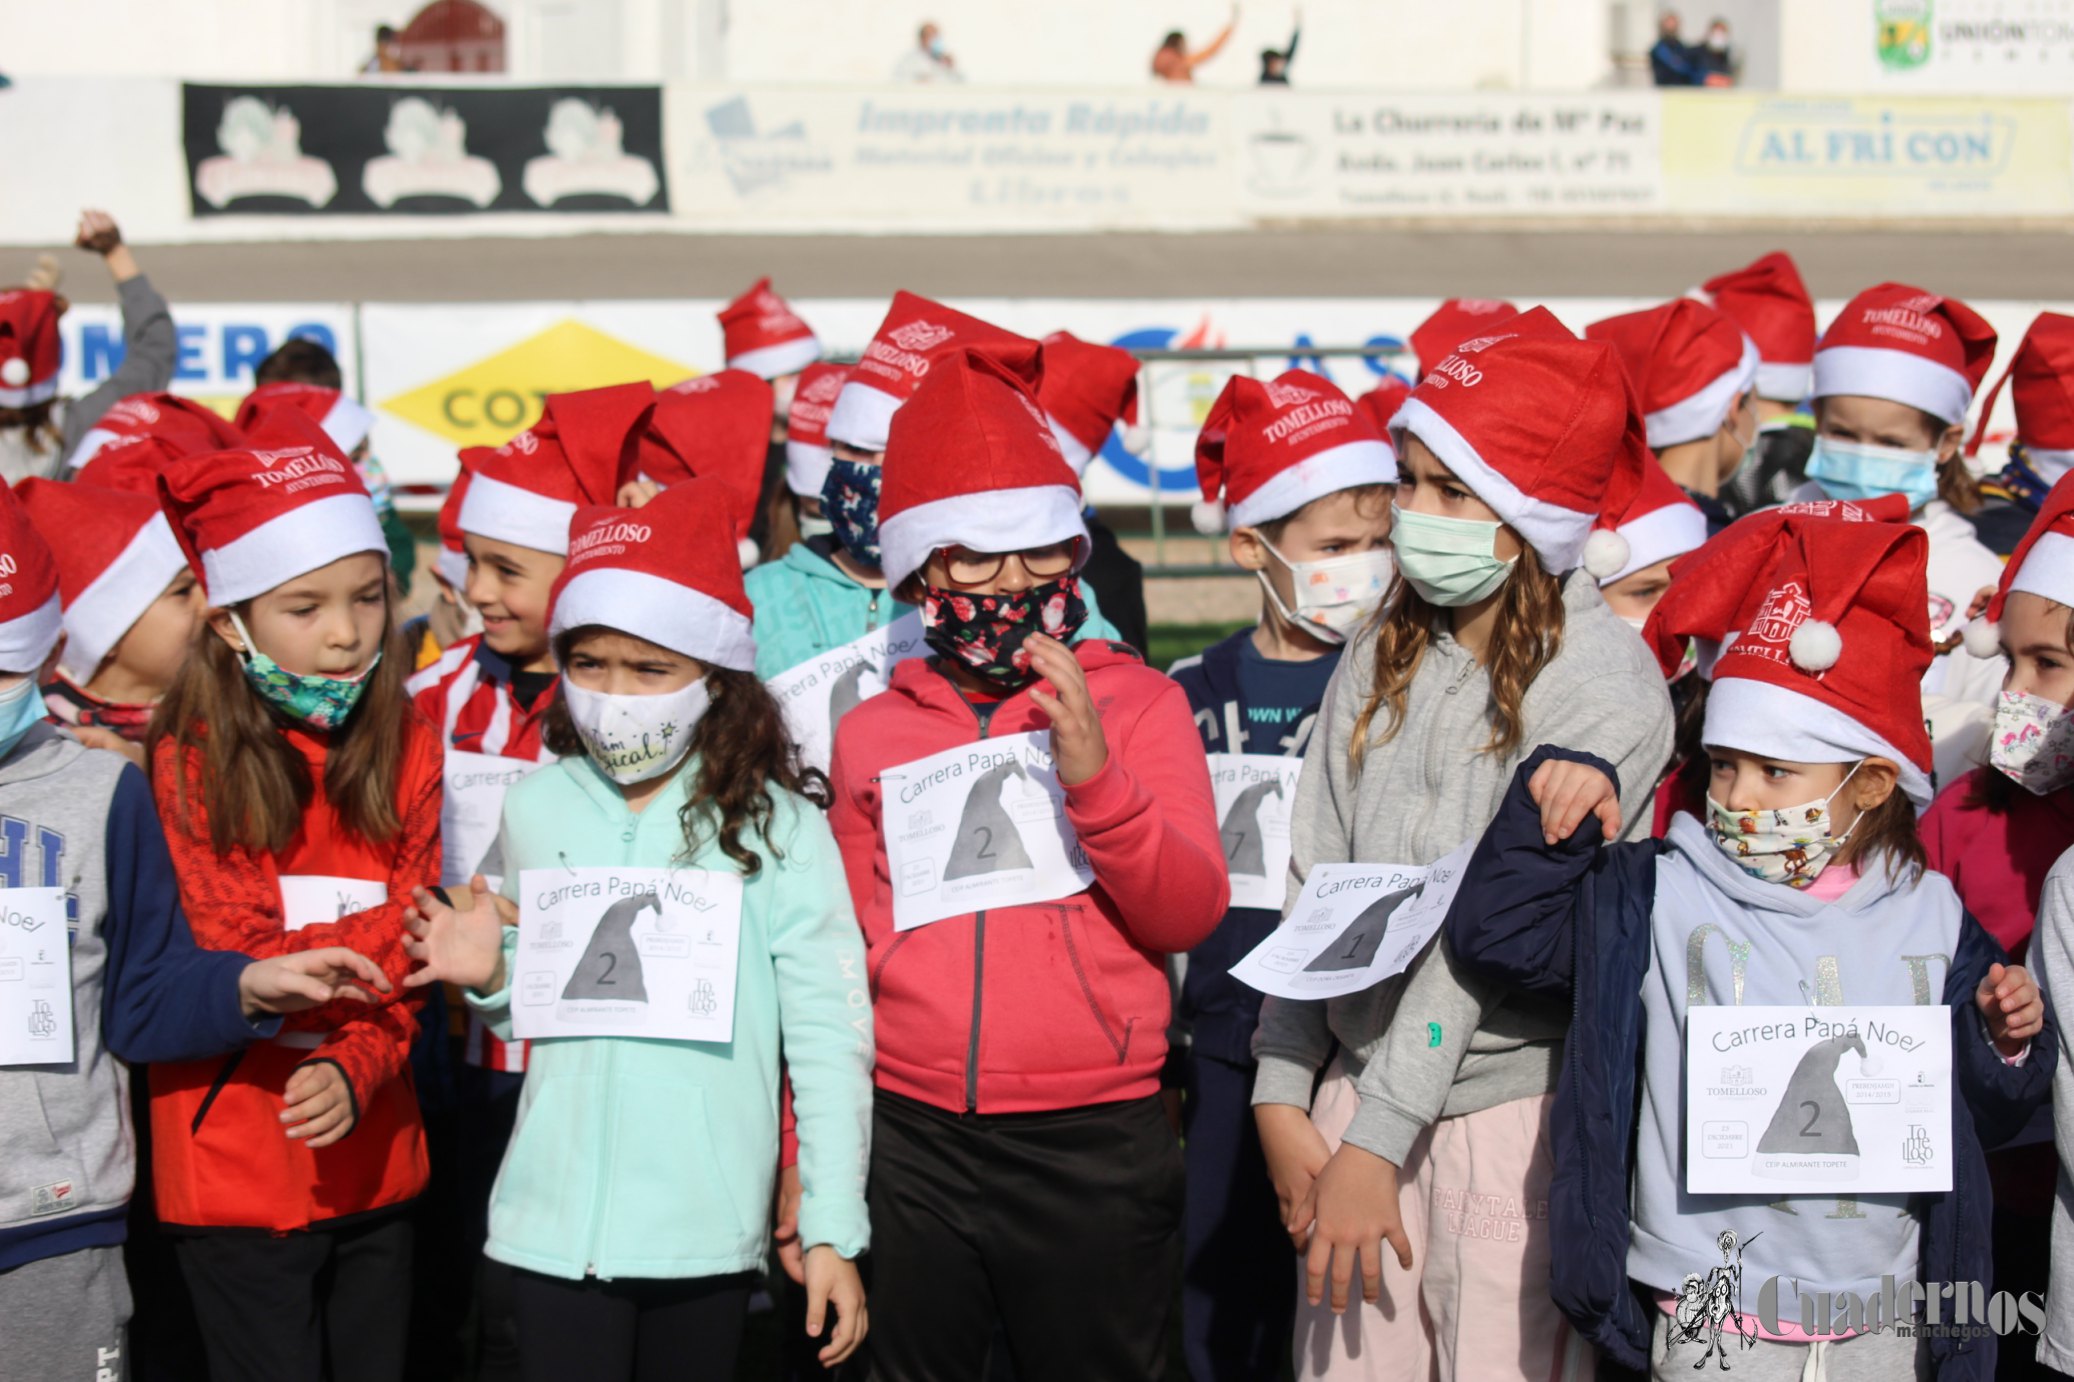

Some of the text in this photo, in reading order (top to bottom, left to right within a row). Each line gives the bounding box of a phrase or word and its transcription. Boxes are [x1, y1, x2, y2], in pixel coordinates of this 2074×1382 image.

[858, 100, 1051, 137] Imprenta
[1761, 131, 1816, 164] AL
[1905, 125, 1993, 165] CON
[1262, 399, 1353, 444] TOMELLOSO
[871, 637, 919, 660] Noel
[451, 768, 511, 791] Carrera
[899, 763, 963, 805] Carrera
[967, 746, 1017, 773] Papá
[1240, 765, 1281, 785] Papá
[973, 826, 997, 860] 2
[537, 877, 719, 913] Carrera Papá Noel
[1316, 875, 1382, 899] Carrera
[1340, 932, 1365, 960] 1
[596, 951, 617, 986] 2
[1712, 1017, 1926, 1053] Carrera Papá Noel
[1706, 1087, 1768, 1097] TOMELLOSO
[1798, 1100, 1823, 1138] 2
[1781, 1160, 1821, 1168] ALMIRANTE
[1822, 1160, 1848, 1168] TOPETE
[1432, 1188, 1549, 1221] FAIYTALE
